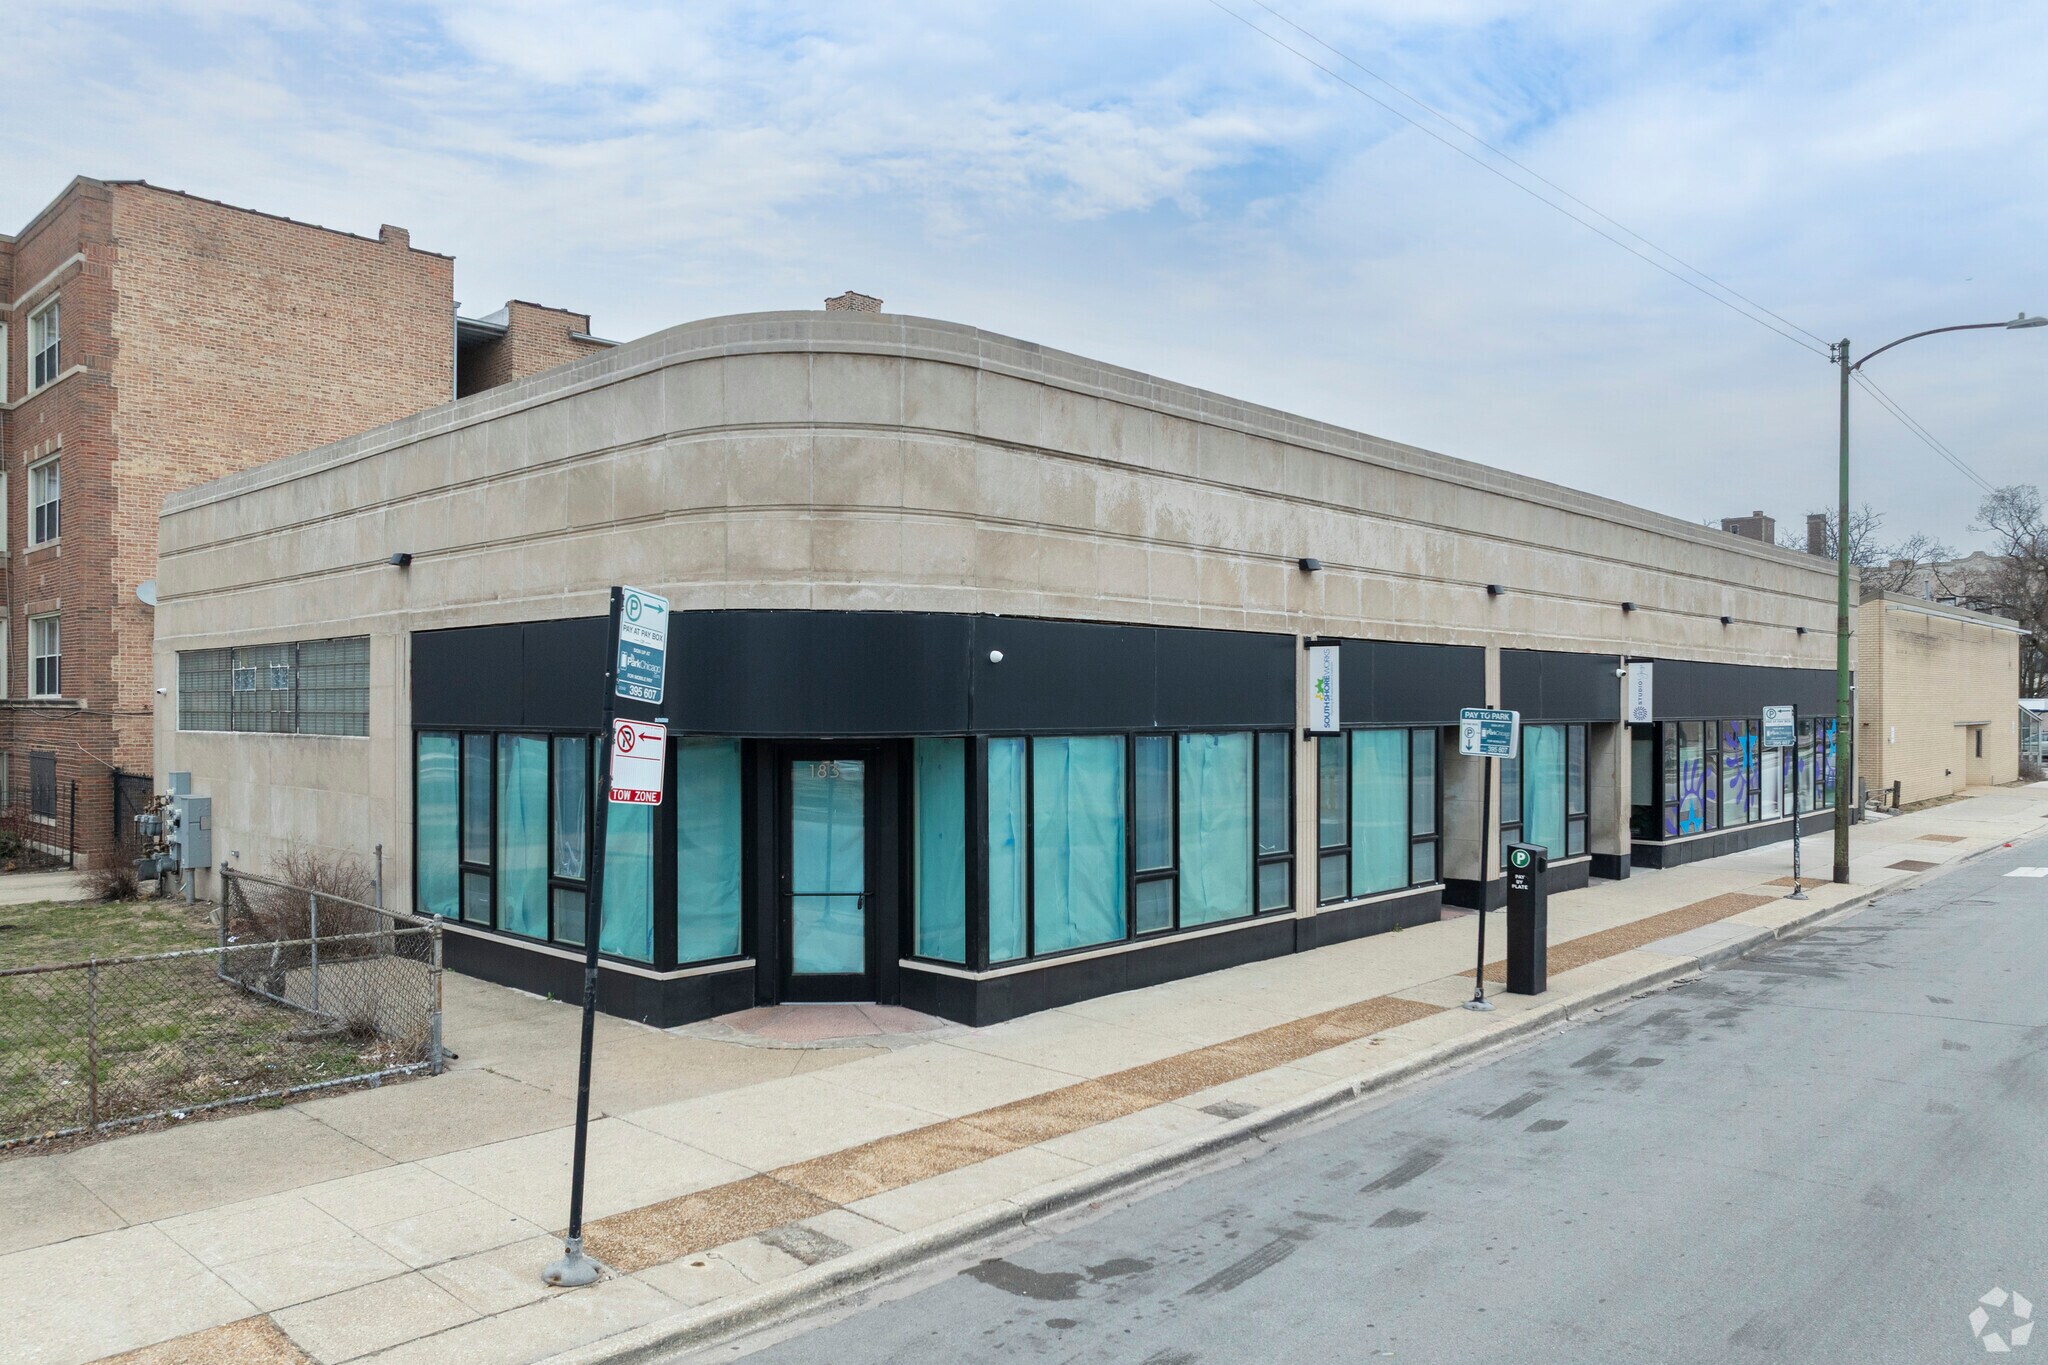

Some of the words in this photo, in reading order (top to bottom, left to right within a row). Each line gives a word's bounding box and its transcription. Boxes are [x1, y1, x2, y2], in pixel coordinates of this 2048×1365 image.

[630, 599, 639, 616] P
[623, 624, 633, 633] PAY
[634, 627, 641, 635] AT
[641, 629, 651, 638] PAY
[652, 632, 663, 641] BOX
[627, 656, 661, 675] ParkChicago
[629, 685, 643, 697] 395
[643, 688, 657, 700] 607
[1464, 711, 1479, 719] PAY
[612, 789, 631, 801] TOW
[634, 791, 657, 802] ZONE
[1516, 851, 1526, 865] P
